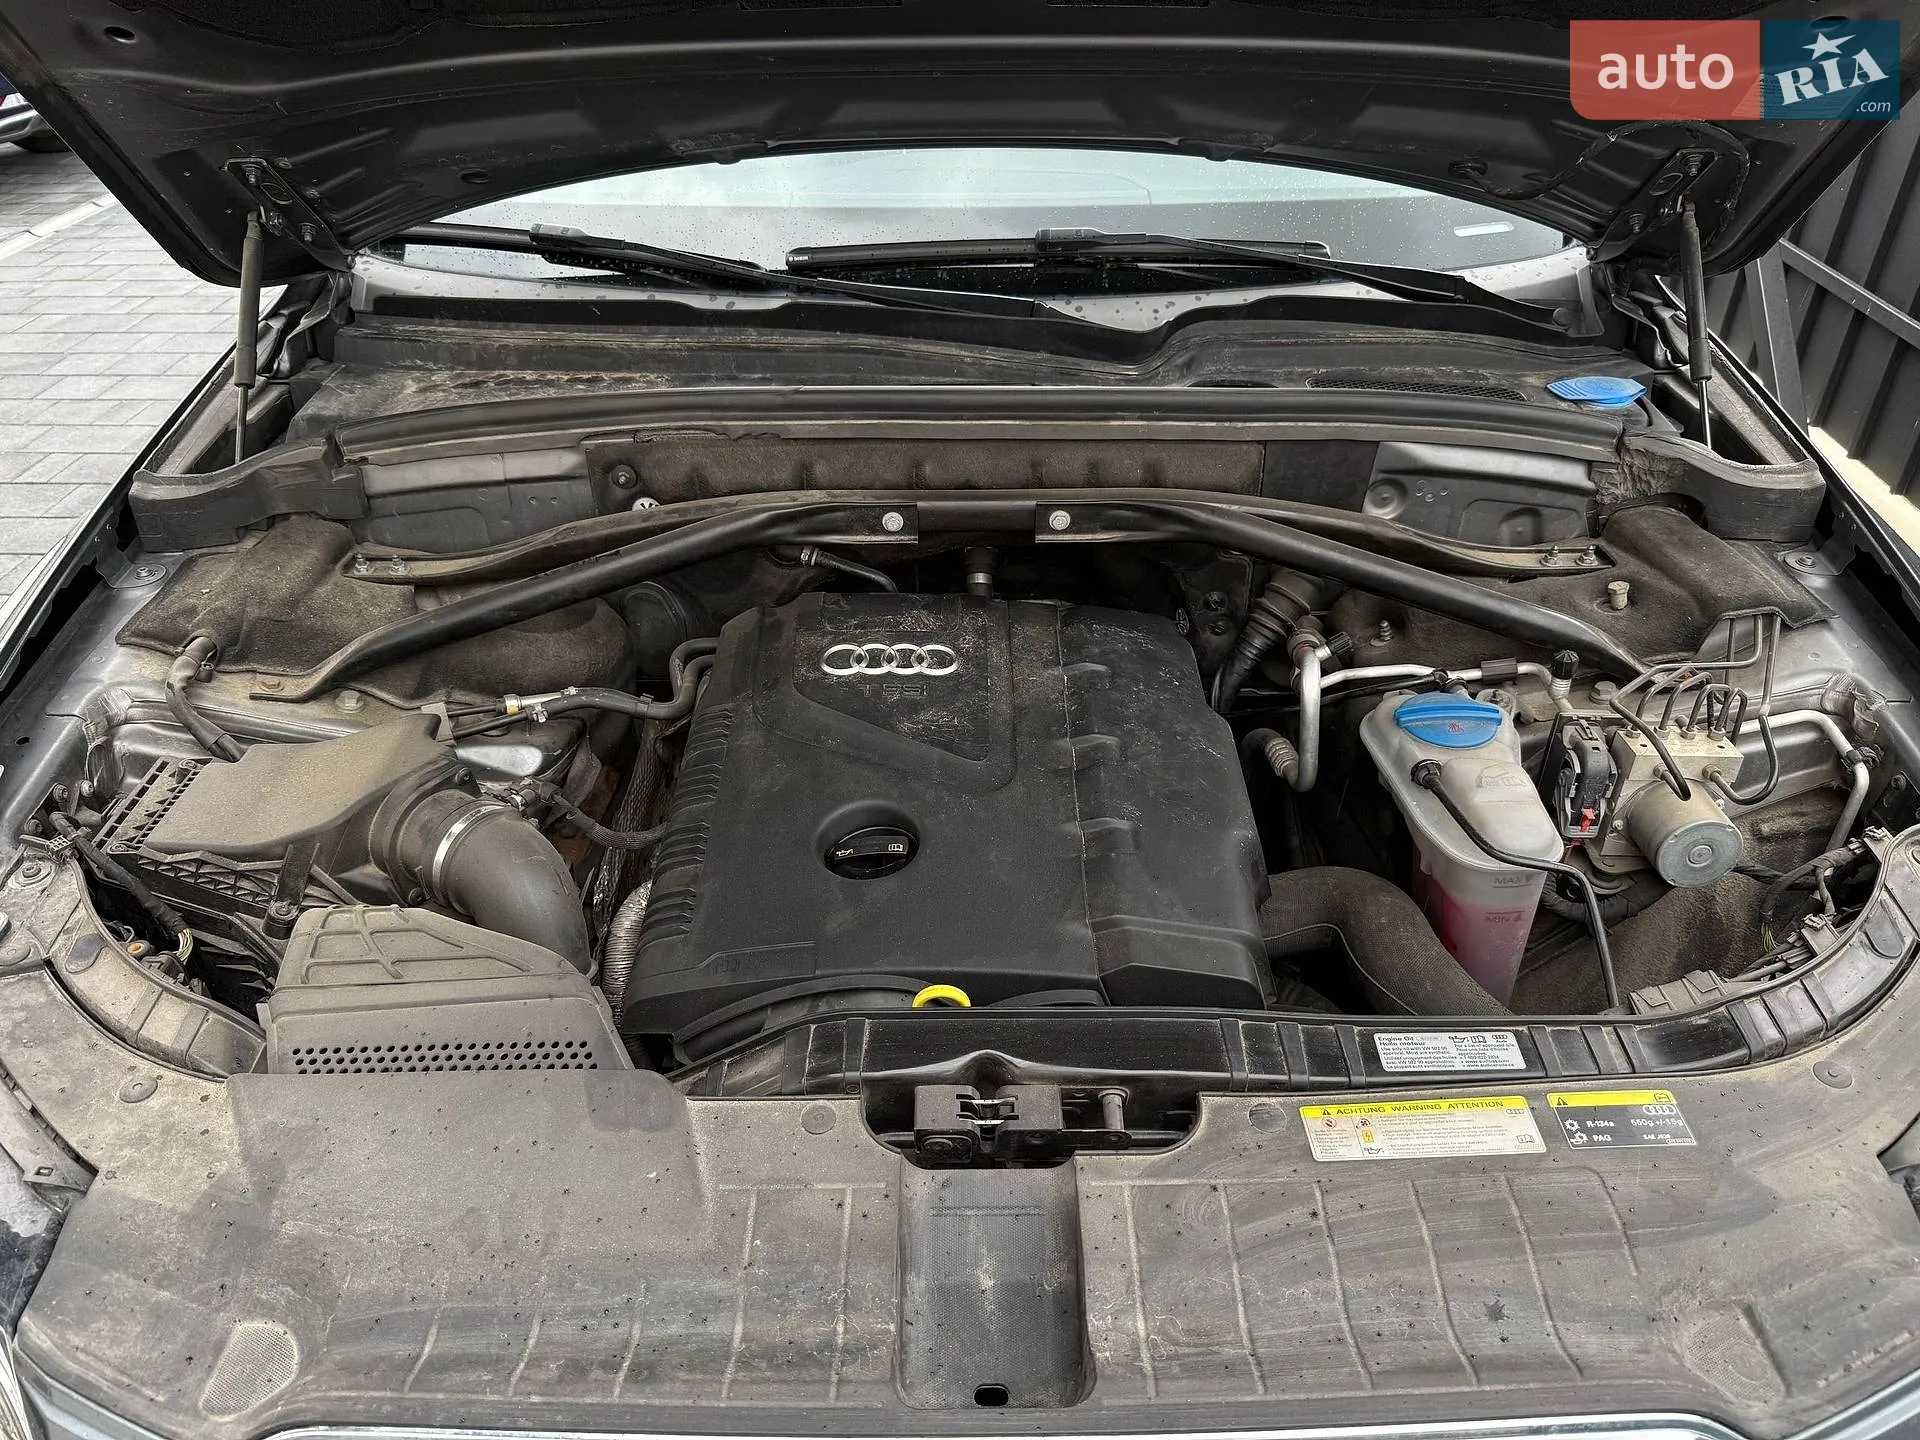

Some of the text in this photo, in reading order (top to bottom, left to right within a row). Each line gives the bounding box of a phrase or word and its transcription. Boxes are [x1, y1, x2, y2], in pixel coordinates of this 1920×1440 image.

[1336, 1101, 1504, 1115] ACHTUNG WARNING ATTENTION
